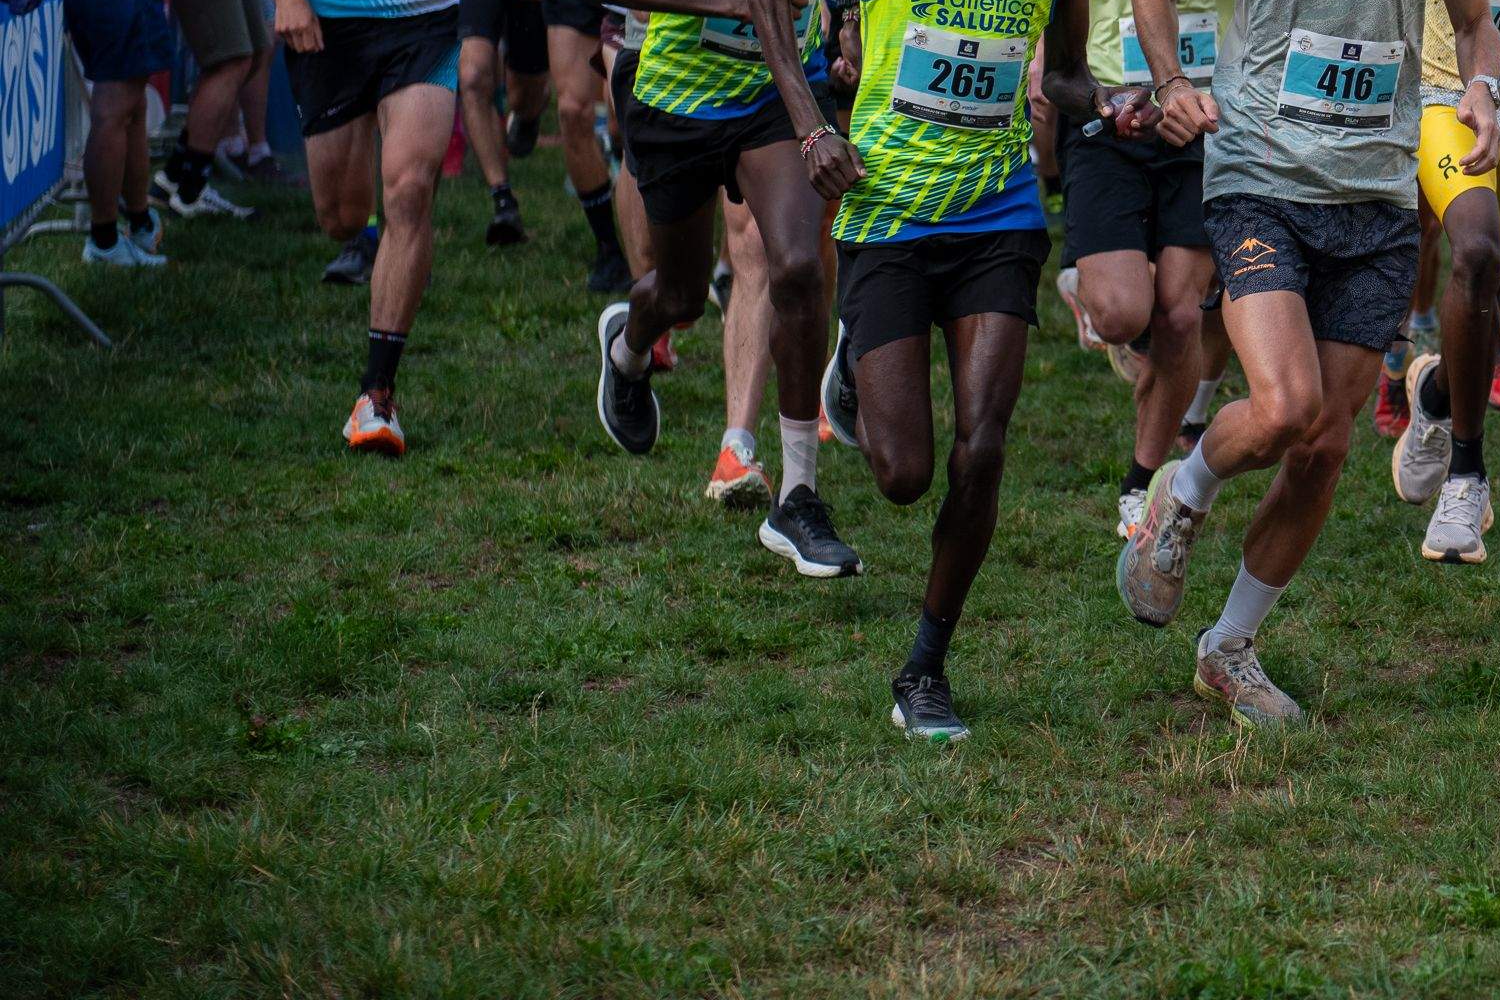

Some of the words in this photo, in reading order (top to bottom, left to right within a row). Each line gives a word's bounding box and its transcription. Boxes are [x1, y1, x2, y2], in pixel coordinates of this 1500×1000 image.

[935, 8, 1031, 34] SALUZZO
[928, 58, 997, 100] 265
[1317, 63, 1376, 100] 416
